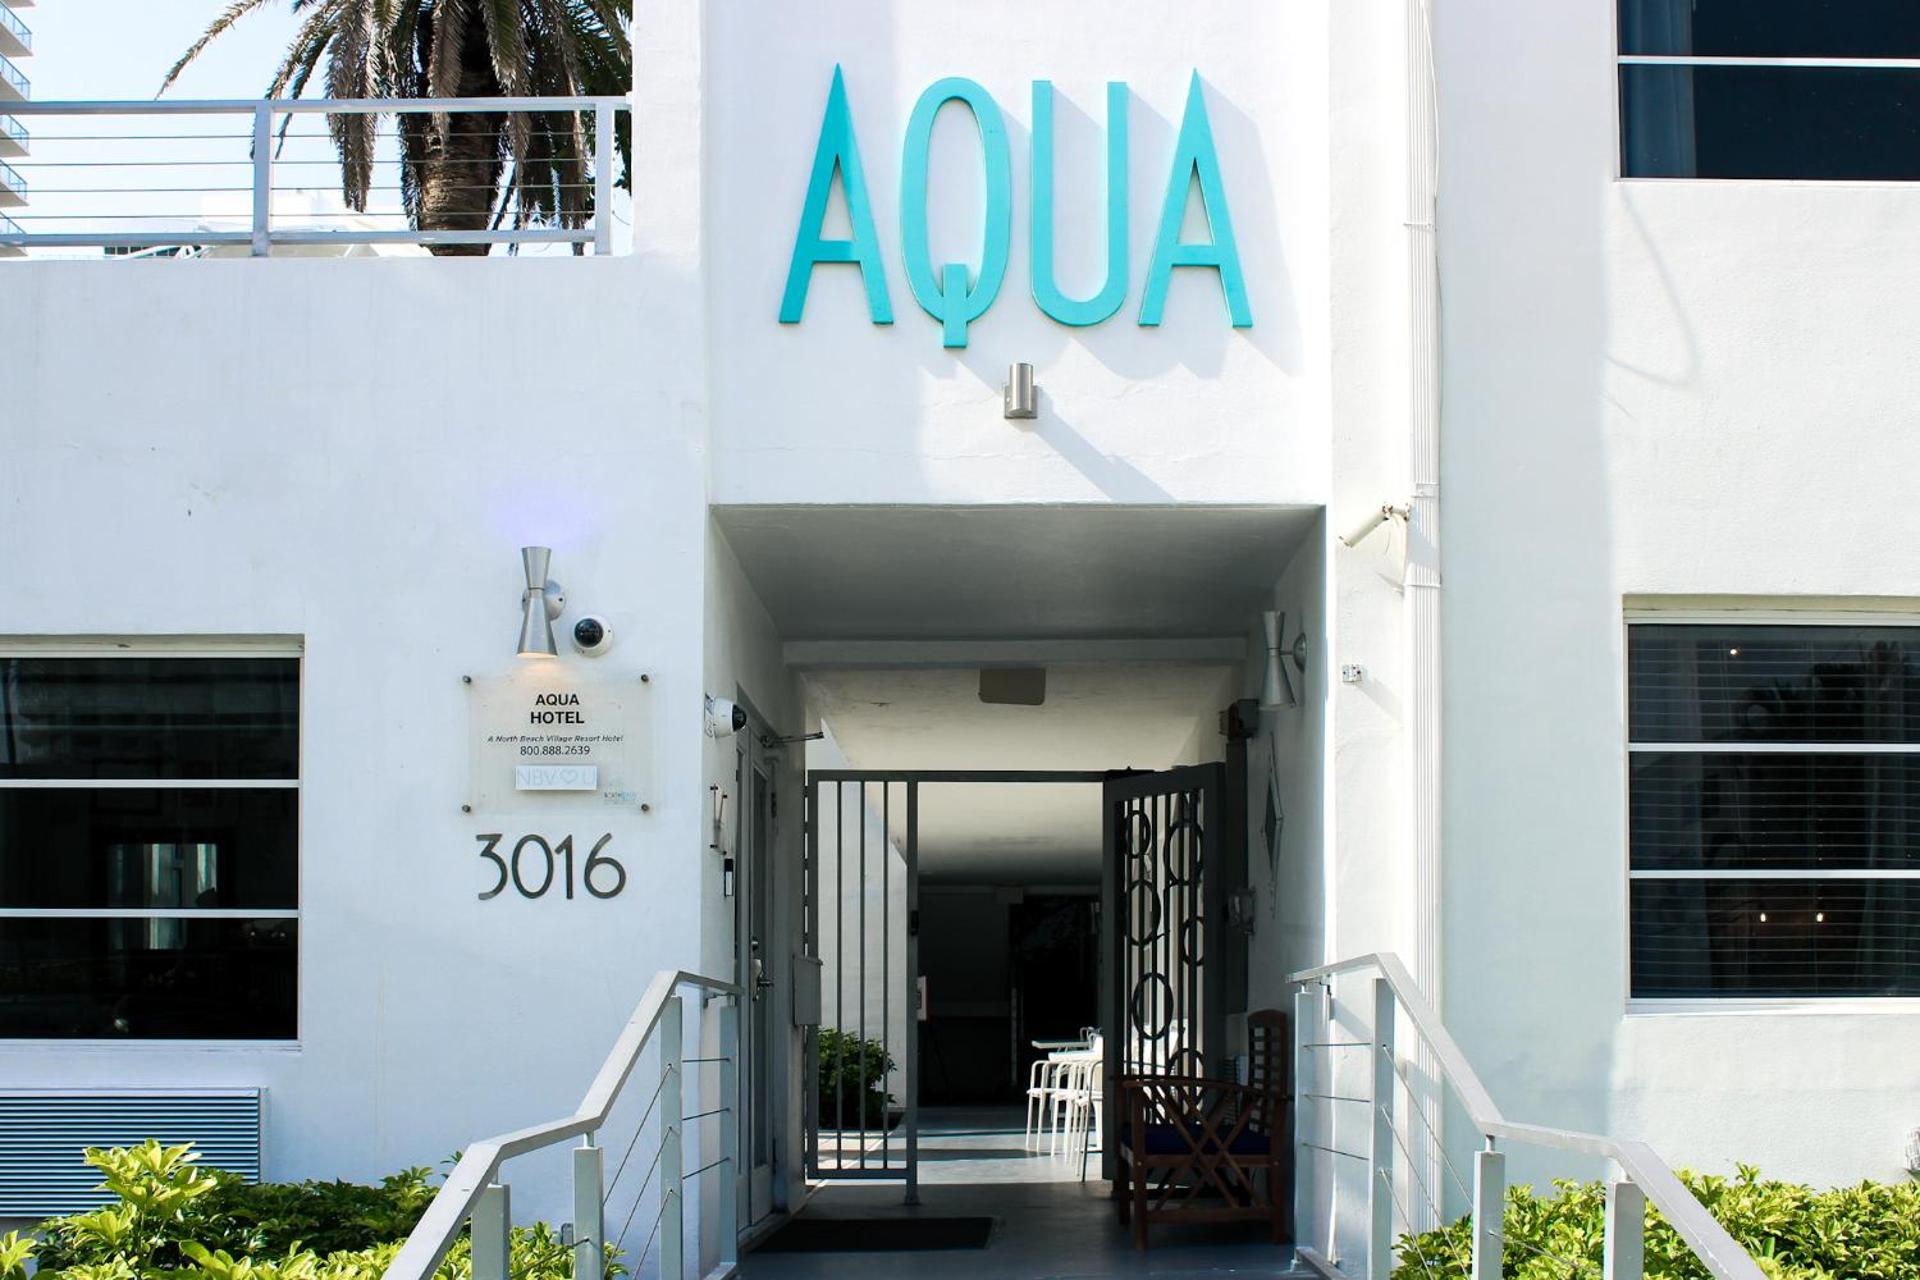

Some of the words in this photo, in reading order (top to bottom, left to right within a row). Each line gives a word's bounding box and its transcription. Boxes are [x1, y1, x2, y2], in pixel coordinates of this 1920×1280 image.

[779, 63, 1253, 348] AQUA
[535, 694, 580, 706] AQUA
[530, 711, 585, 724] HOTEL
[487, 735, 494, 743] A
[496, 735, 518, 743] North
[520, 735, 544, 743] Beach
[547, 735, 573, 743] Village
[574, 735, 600, 743] Resort
[602, 735, 624, 743] Hotel
[520, 745, 591, 756] 800.888.2639
[475, 833, 627, 900] 3016
